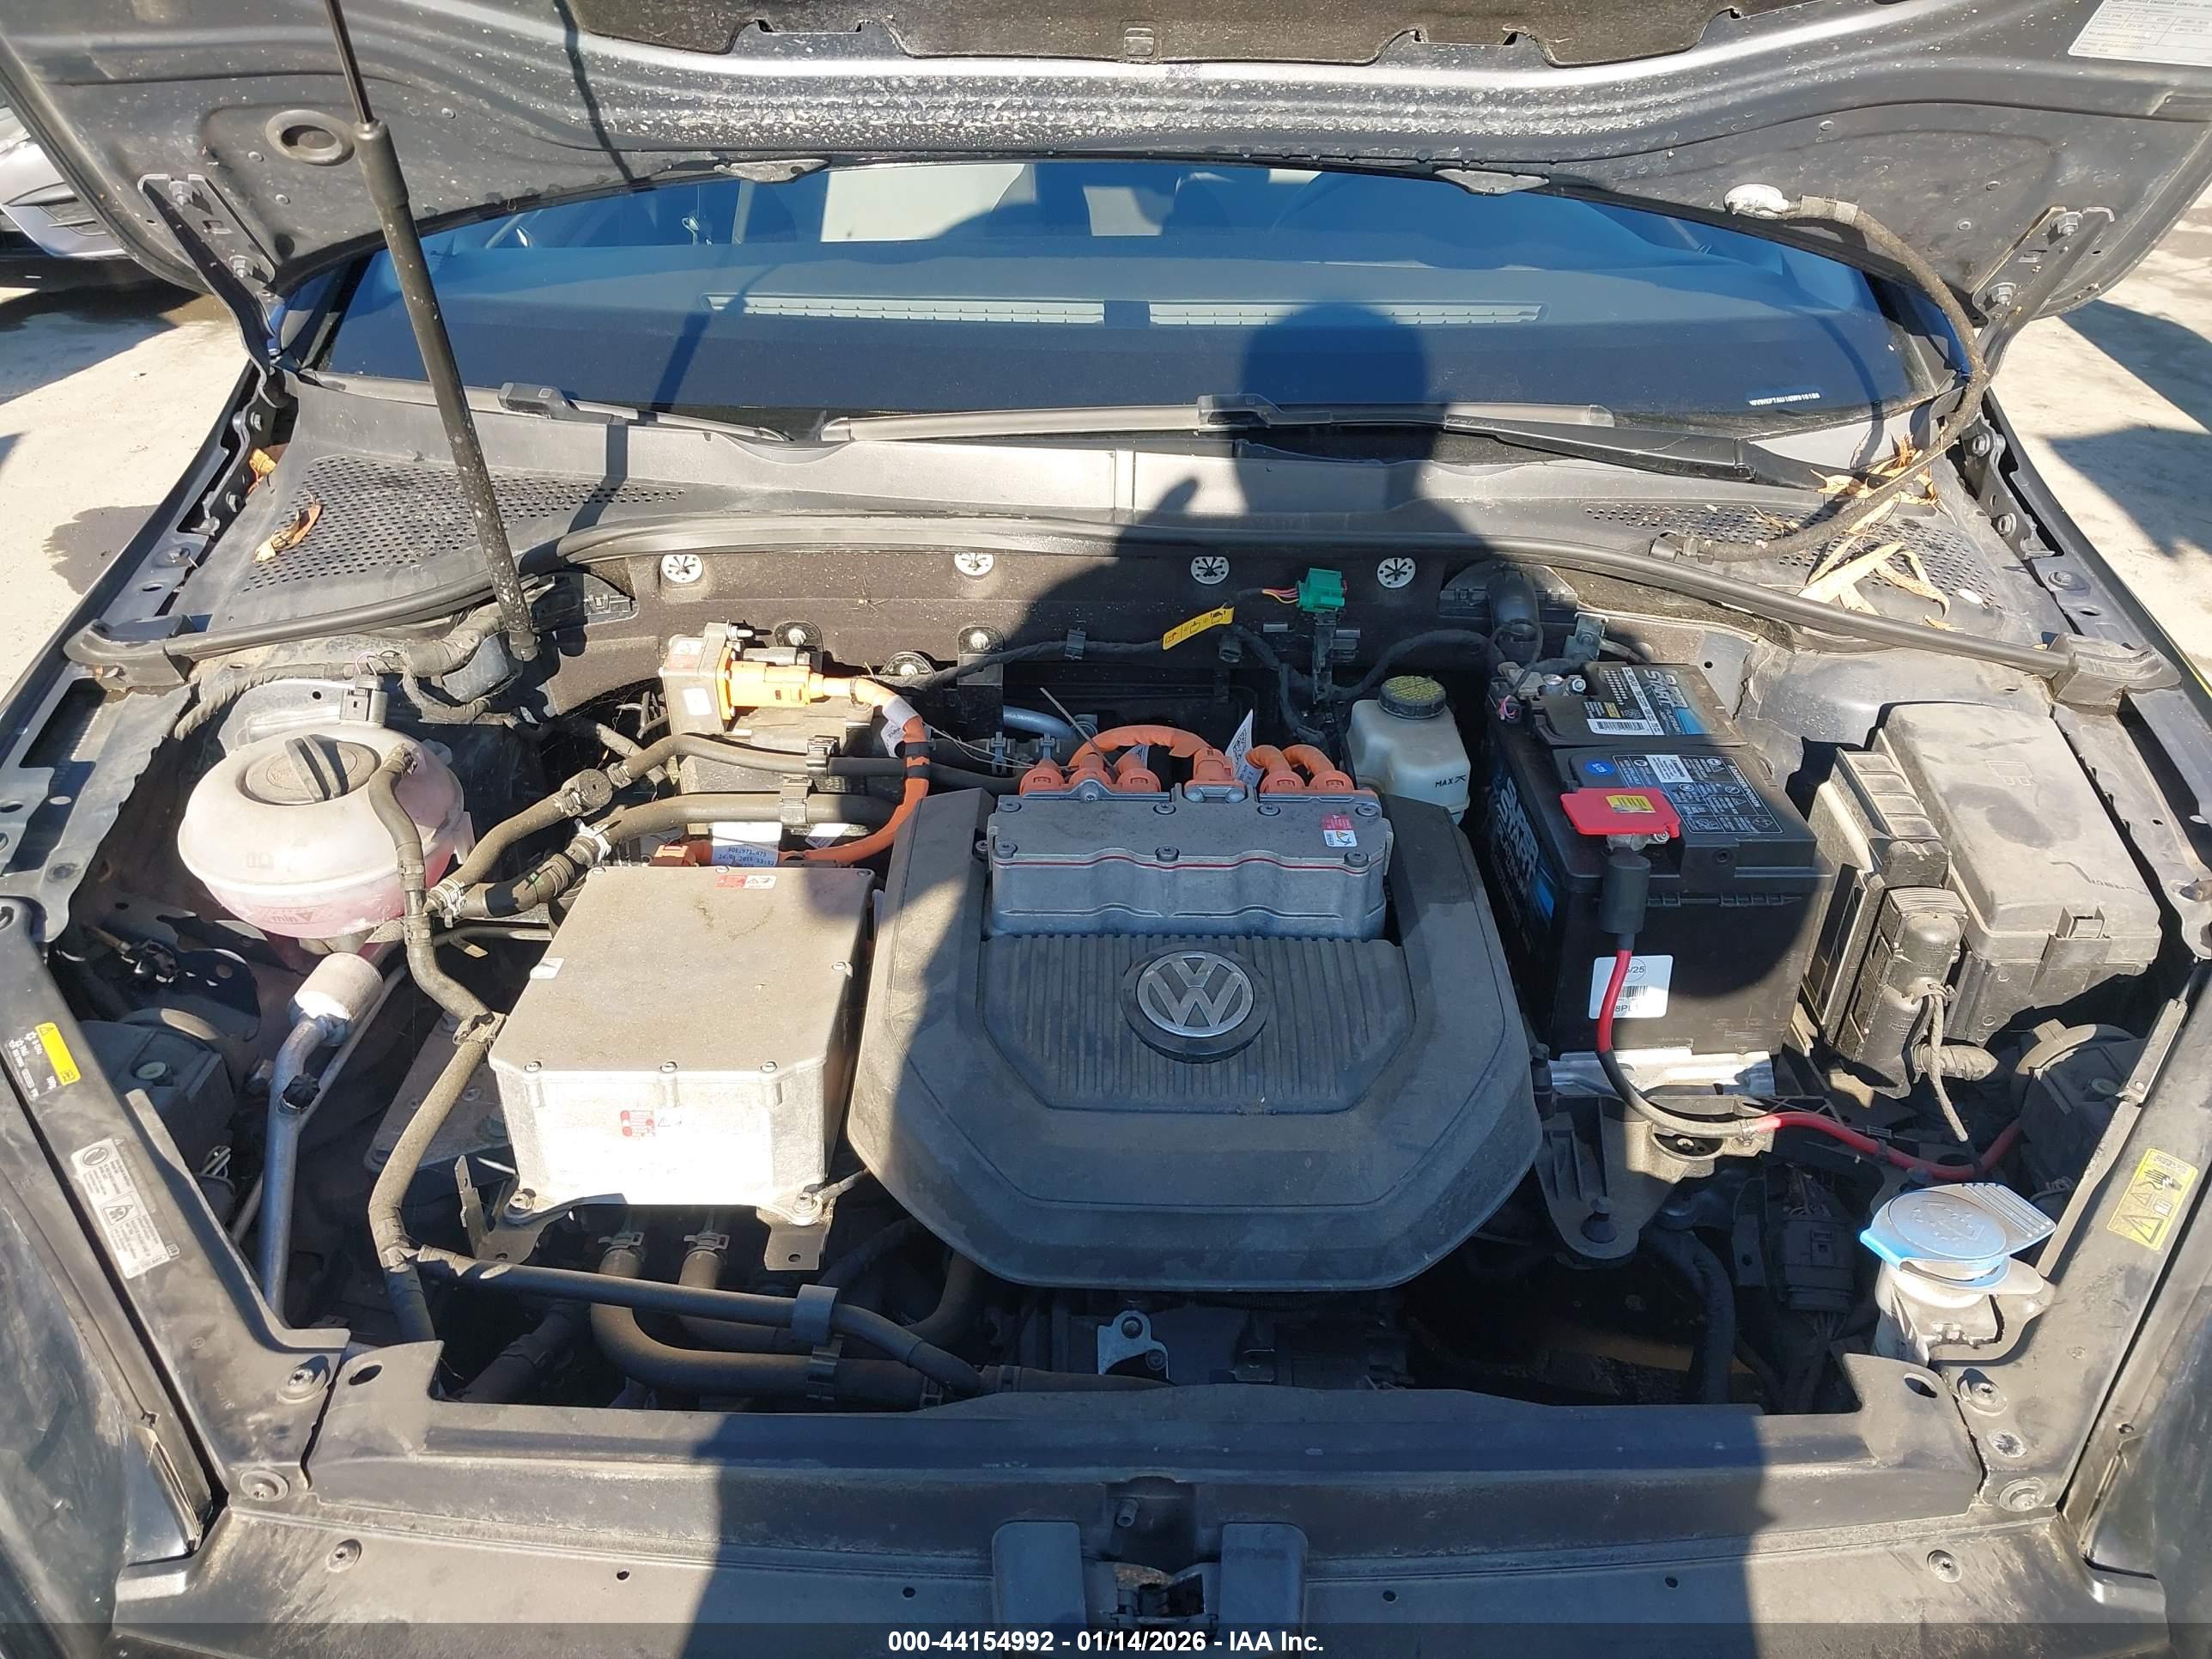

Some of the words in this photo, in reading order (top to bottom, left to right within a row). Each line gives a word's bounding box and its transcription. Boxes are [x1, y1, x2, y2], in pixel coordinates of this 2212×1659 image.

[1644, 670, 1677, 708] START
[1435, 776, 1455, 788] MAX
[1137, 951, 1254, 1037] VW
